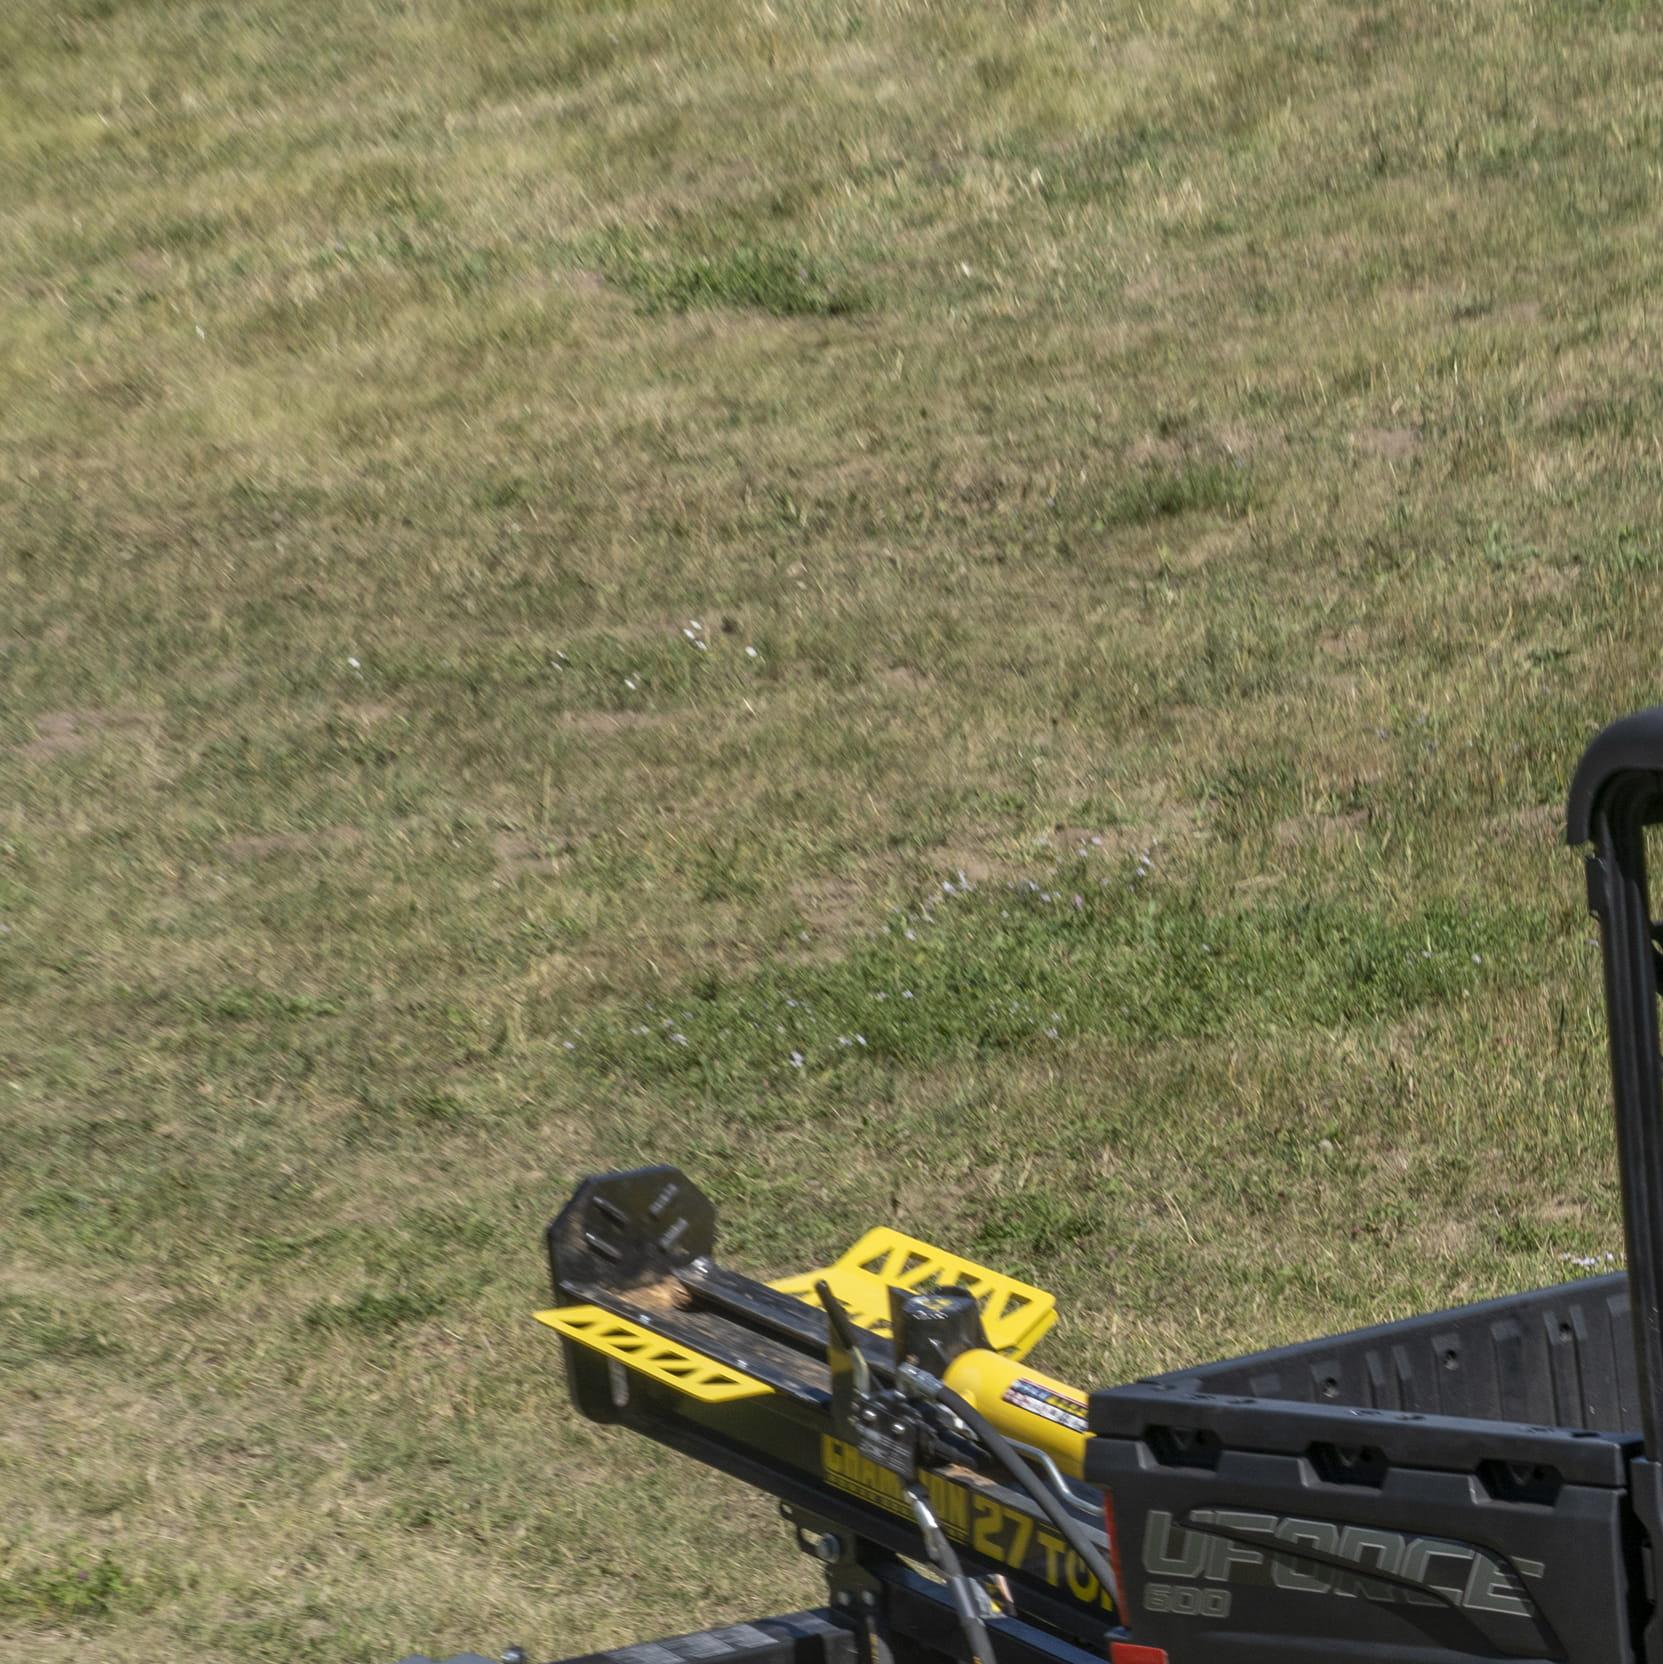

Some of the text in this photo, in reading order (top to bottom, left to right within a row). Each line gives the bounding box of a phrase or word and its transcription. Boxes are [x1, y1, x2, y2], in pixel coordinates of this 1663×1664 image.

[973, 1493, 1034, 1569] 27
[1142, 1509, 1545, 1617] UFORCE
[1143, 1582, 1233, 1618] 600
